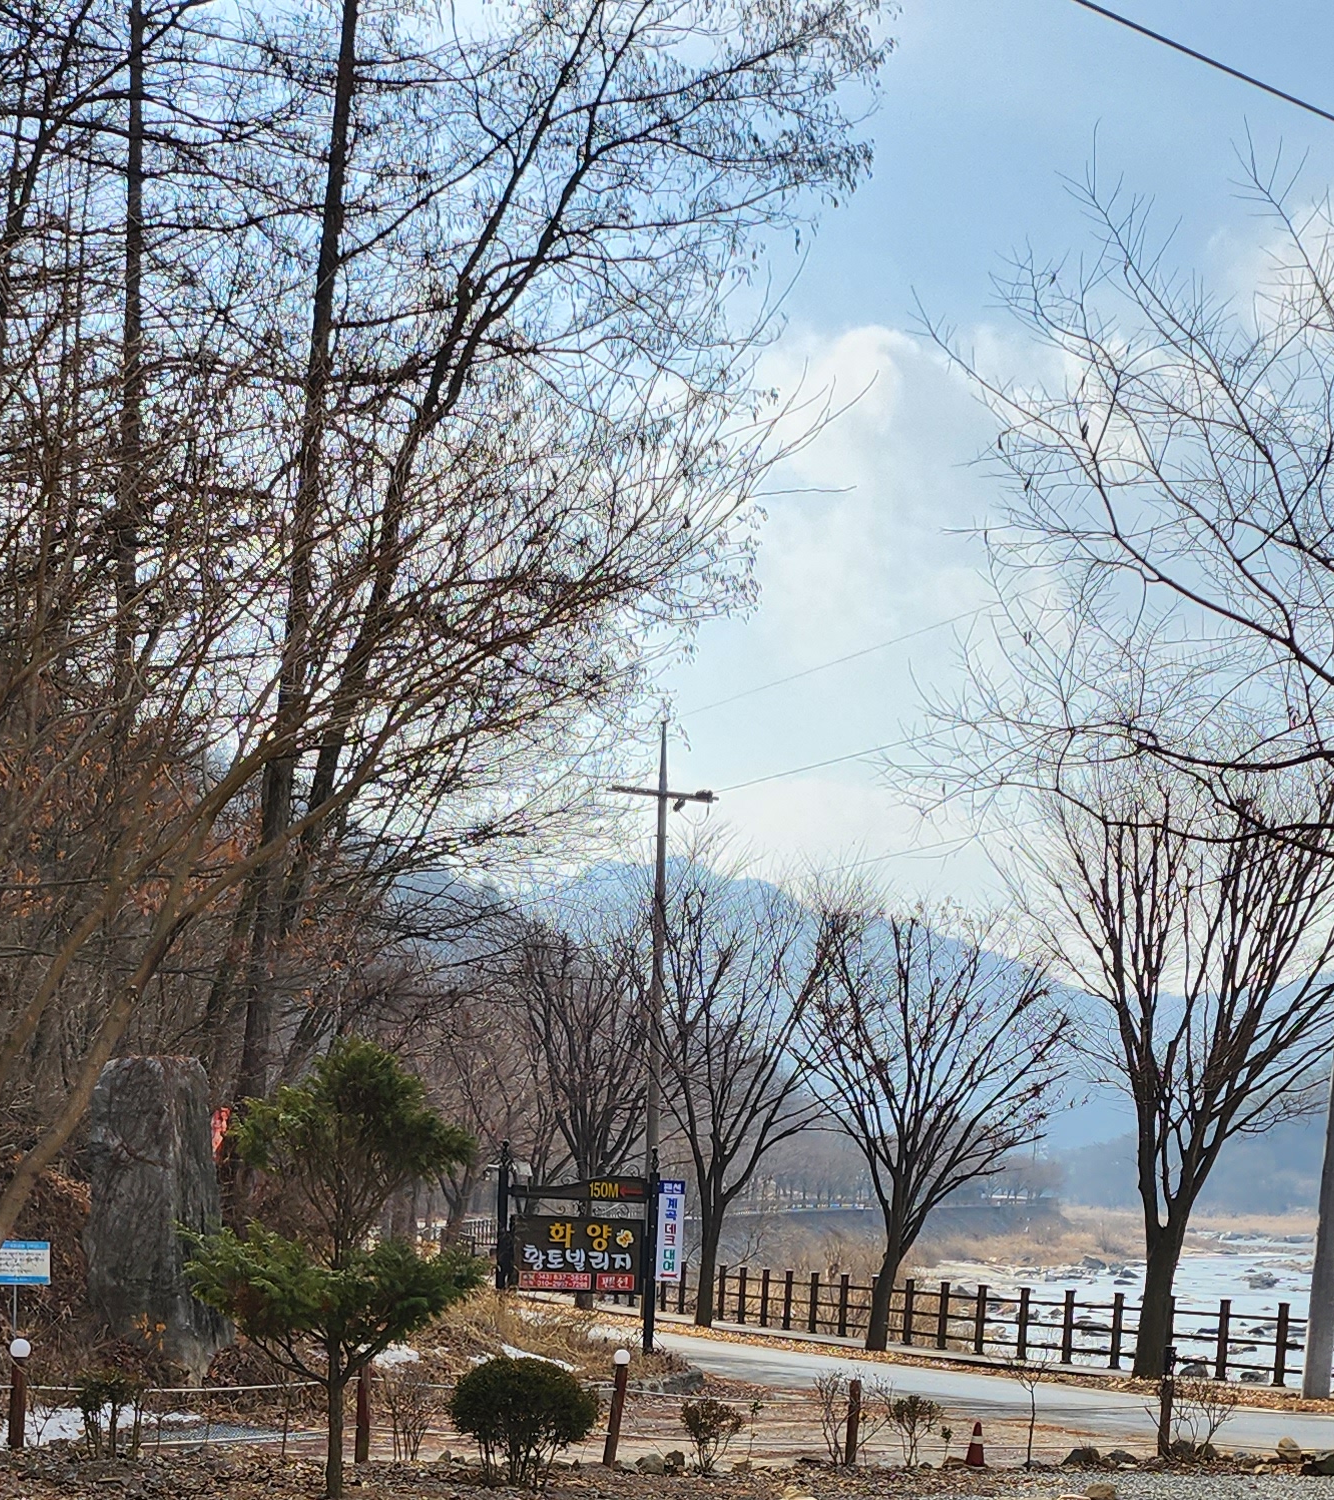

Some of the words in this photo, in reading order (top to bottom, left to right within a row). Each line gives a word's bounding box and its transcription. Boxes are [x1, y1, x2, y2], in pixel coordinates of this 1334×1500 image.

[589, 1181, 619, 1198] 150M
[665, 1197, 678, 1221] 계곡
[663, 1223, 677, 1246] 데크
[523, 1244, 632, 1272] 황토빌리지
[662, 1249, 676, 1272] 대여
